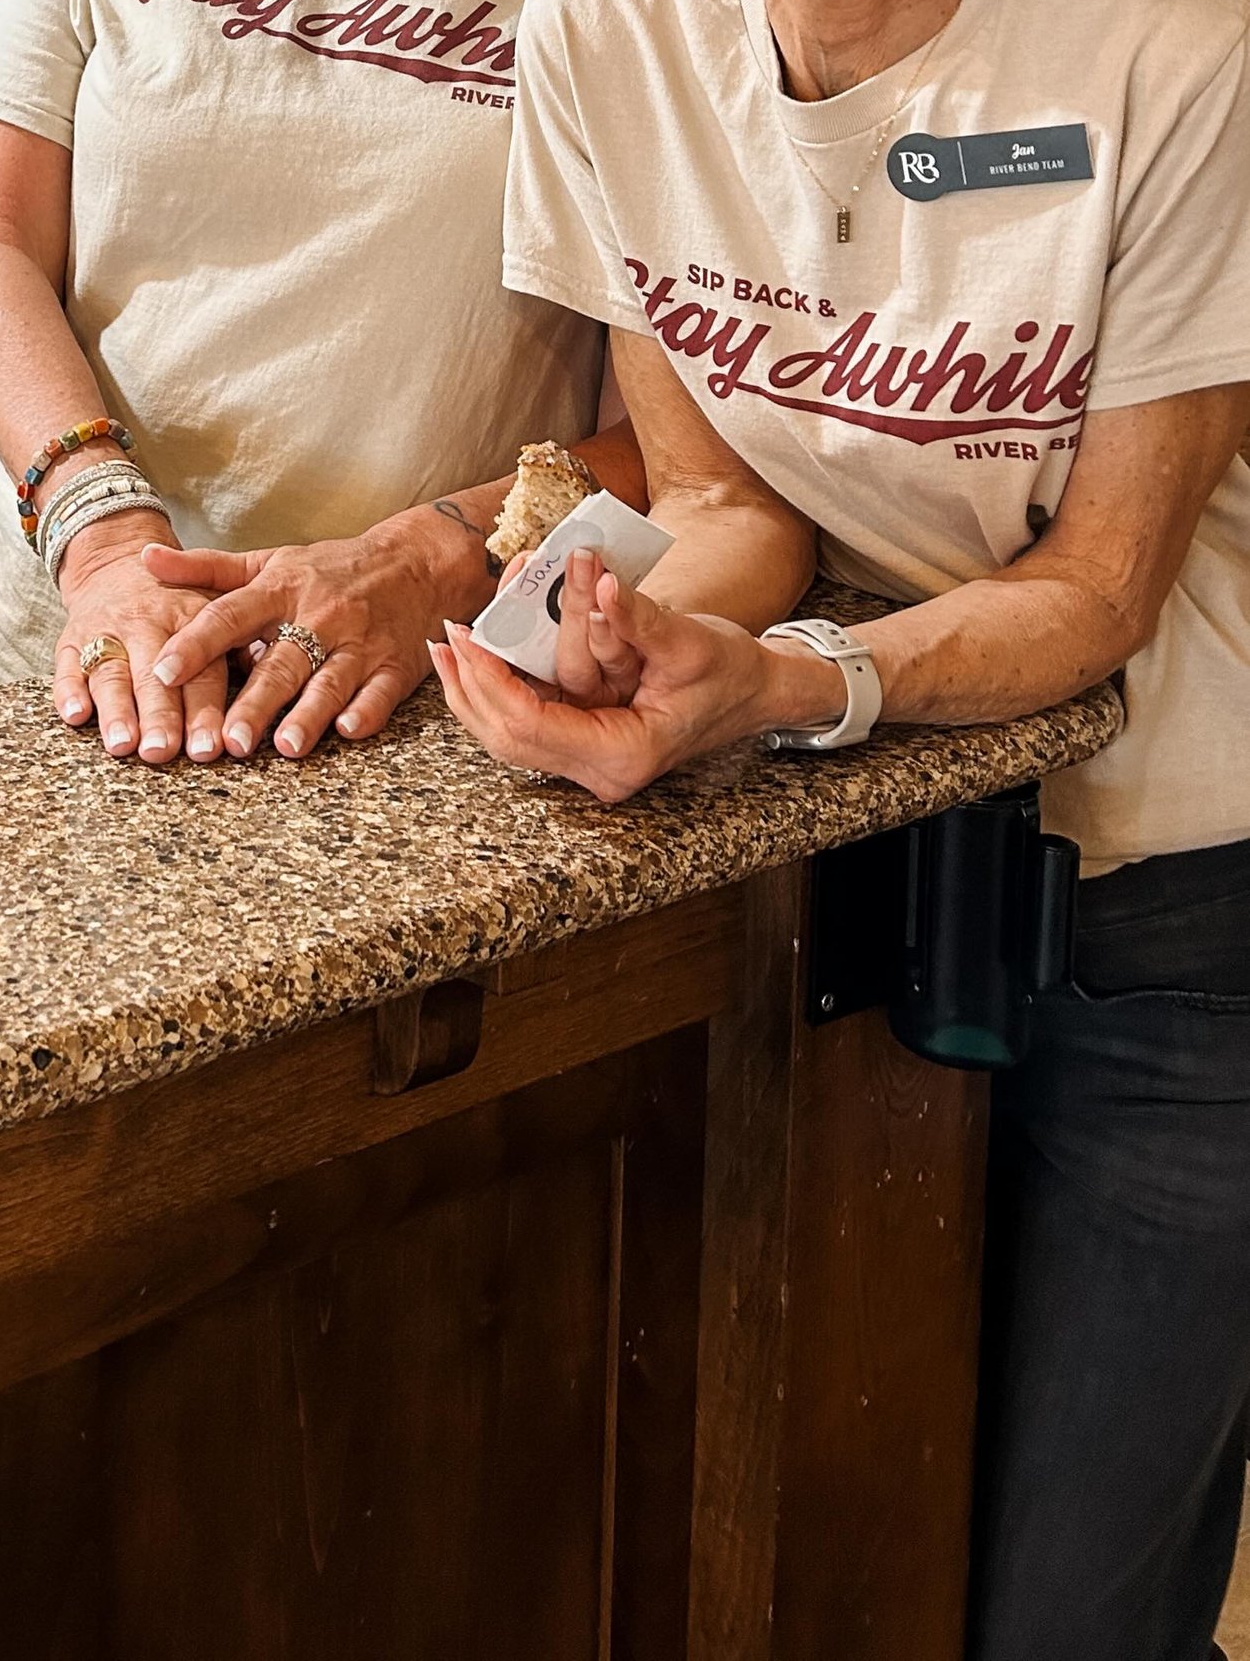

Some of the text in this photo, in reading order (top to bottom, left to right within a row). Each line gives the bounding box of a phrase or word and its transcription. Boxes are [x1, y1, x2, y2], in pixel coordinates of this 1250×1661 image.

[1011, 143, 1035, 160] Jan
[989, 159, 1065, 175] RIVER BEND TEAM
[687, 264, 838, 318] SIP BACK &
[955, 441, 1038, 462] RIVER
[519, 554, 561, 596] Jan
